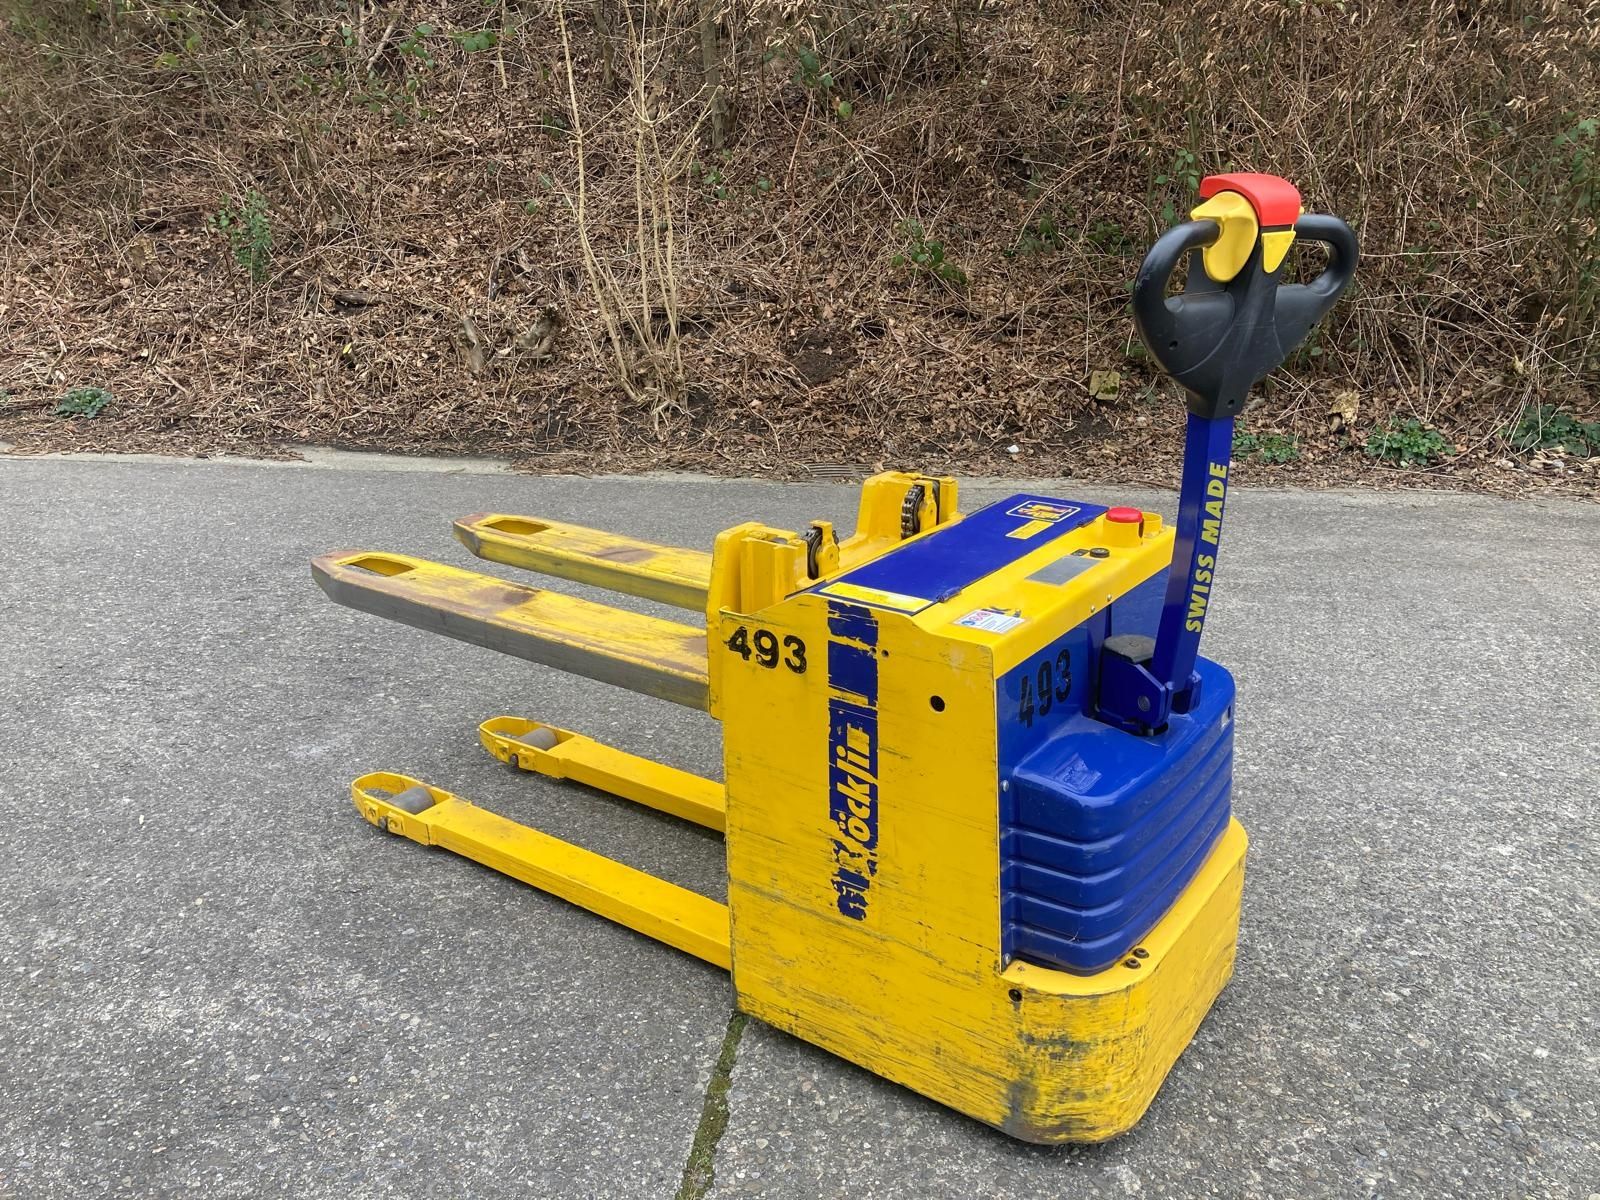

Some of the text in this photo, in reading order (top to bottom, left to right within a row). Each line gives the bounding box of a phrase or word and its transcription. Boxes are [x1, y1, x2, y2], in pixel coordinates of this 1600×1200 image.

[1186, 462, 1228, 633] SWISS MADE
[723, 625, 807, 674] 493
[1019, 648, 1072, 729] 493
